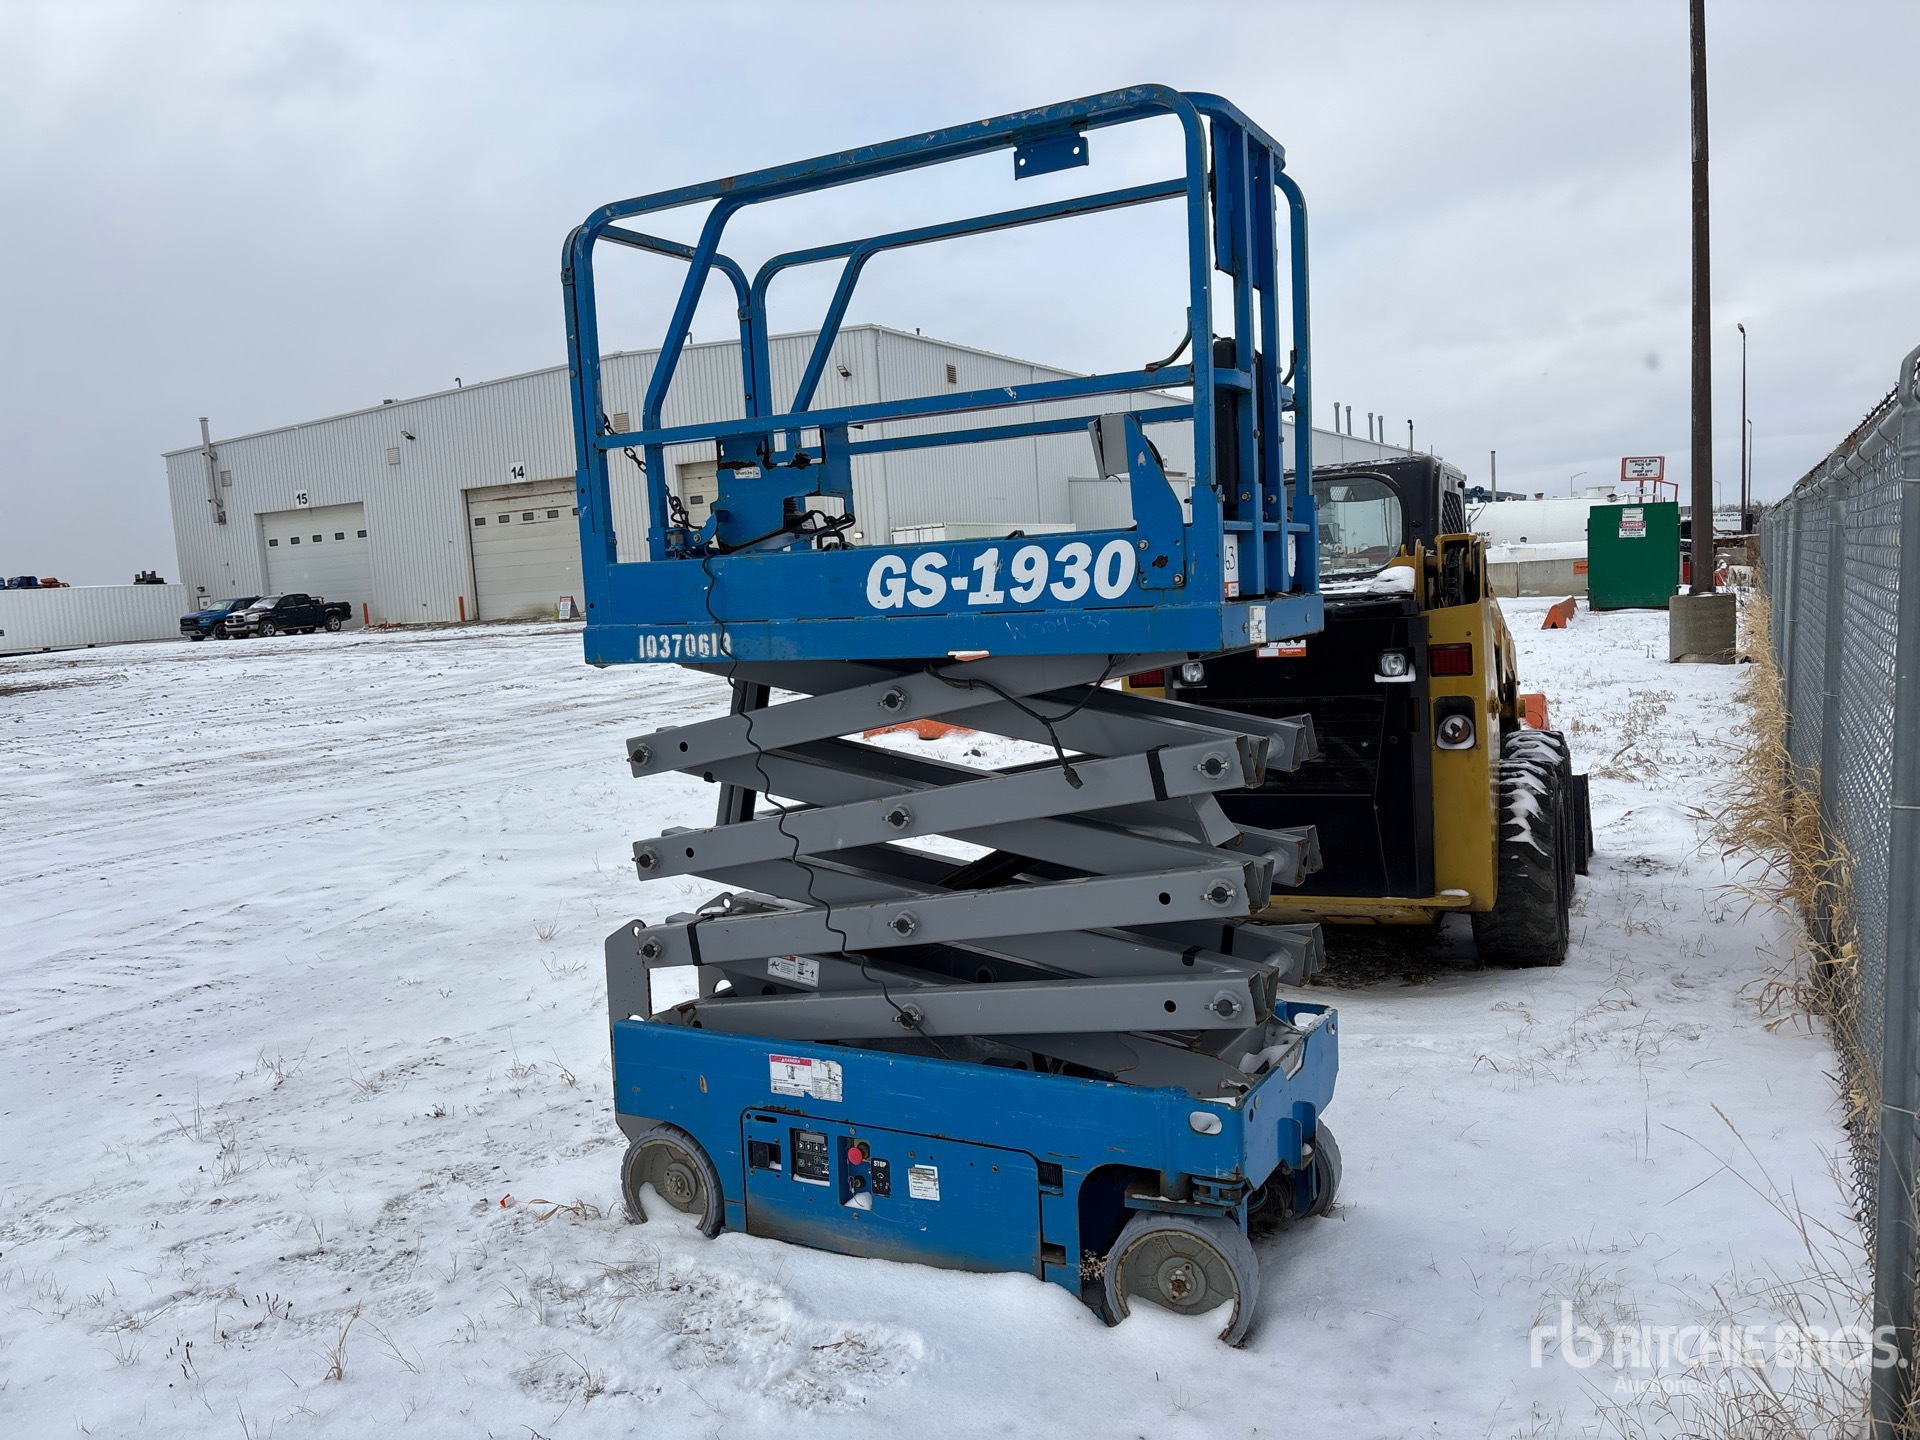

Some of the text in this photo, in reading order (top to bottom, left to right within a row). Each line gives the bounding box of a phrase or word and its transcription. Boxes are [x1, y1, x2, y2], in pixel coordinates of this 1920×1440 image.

[511, 466, 525, 479] 14
[296, 493, 308, 505] 15
[866, 539, 1136, 610] GS-1930
[873, 1160, 887, 1168] STOP
